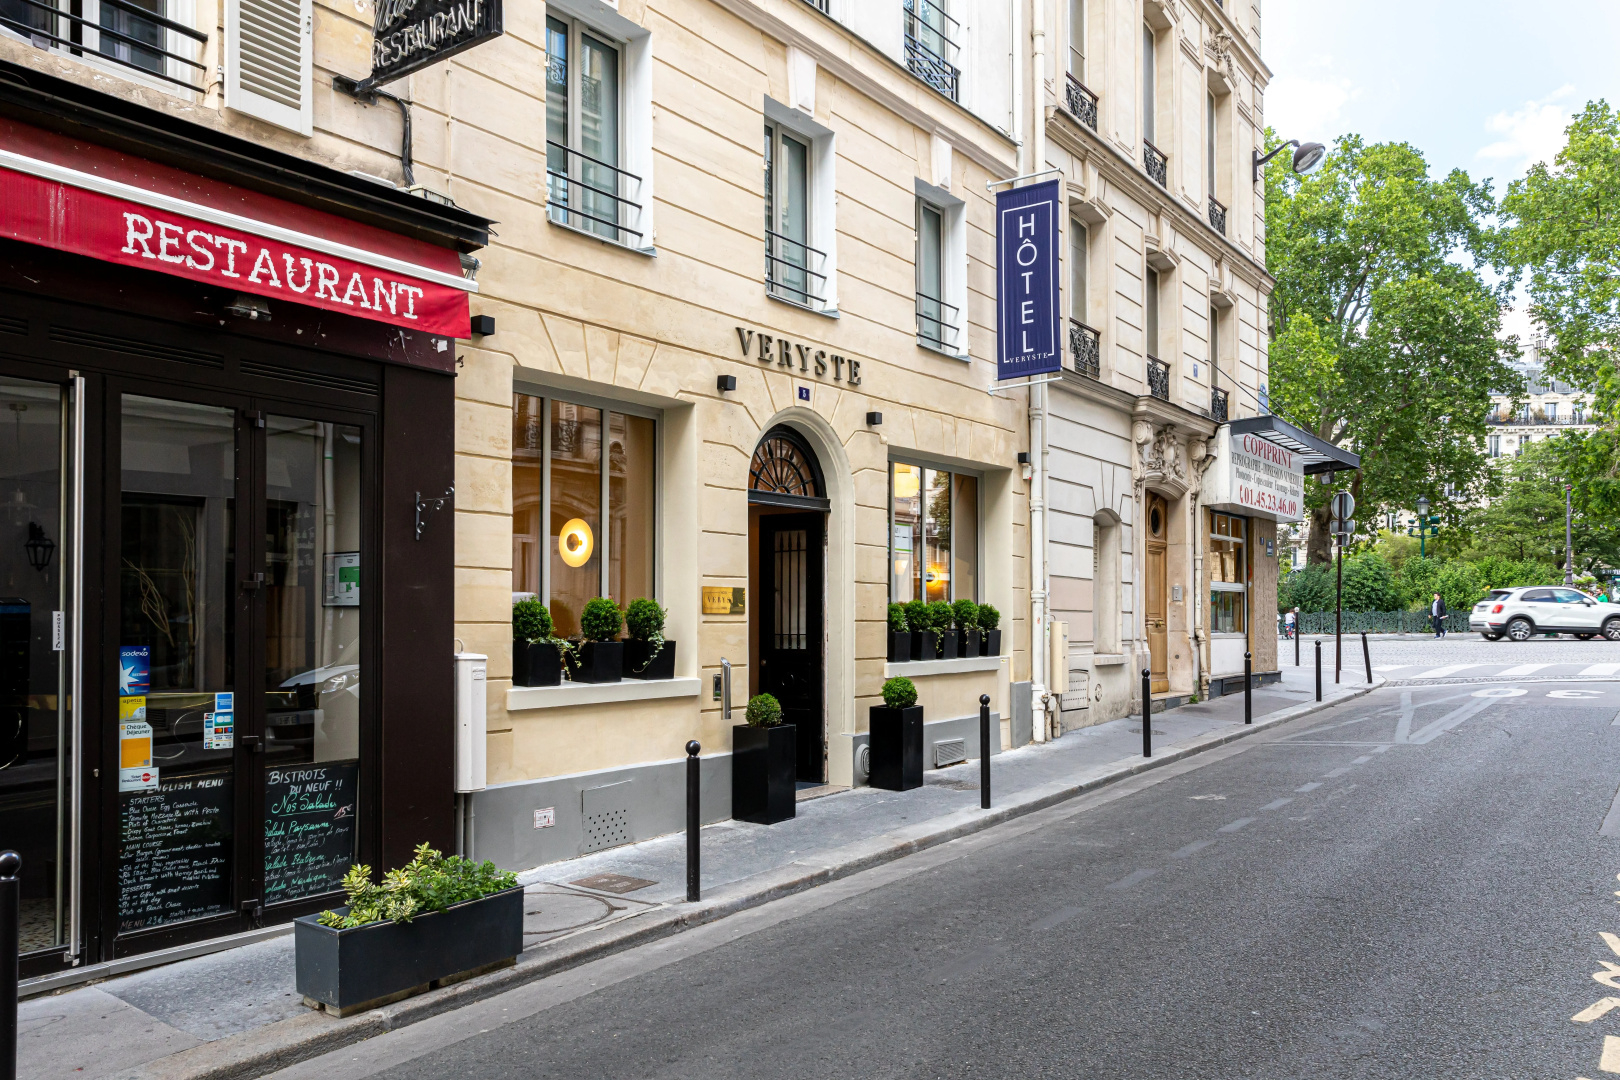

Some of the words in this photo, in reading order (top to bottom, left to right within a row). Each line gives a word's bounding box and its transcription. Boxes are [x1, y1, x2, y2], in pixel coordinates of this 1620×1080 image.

[370, 0, 484, 67] RESTAURANT
[121, 211, 424, 320] RESTAURANT
[1017, 213, 1038, 354] HÔTEL
[735, 326, 862, 386] VERYSTE
[1009, 352, 1049, 364] VERYSTE
[1243, 434, 1293, 469] COPIPRINT
[1244, 486, 1297, 517] 01.45.23.46.09
[121, 648, 148, 657] sodexo
[196, 778, 224, 789] MENU
[267, 768, 328, 785] BISTROTS
[305, 780, 333, 793] NEUF
[334, 779, 343, 791] !!
[129, 794, 166, 806] STARTERS
[271, 792, 298, 814] Nos
[299, 792, 337, 811] Salades
[265, 880, 287, 893] alade
[120, 918, 146, 930] MENU
